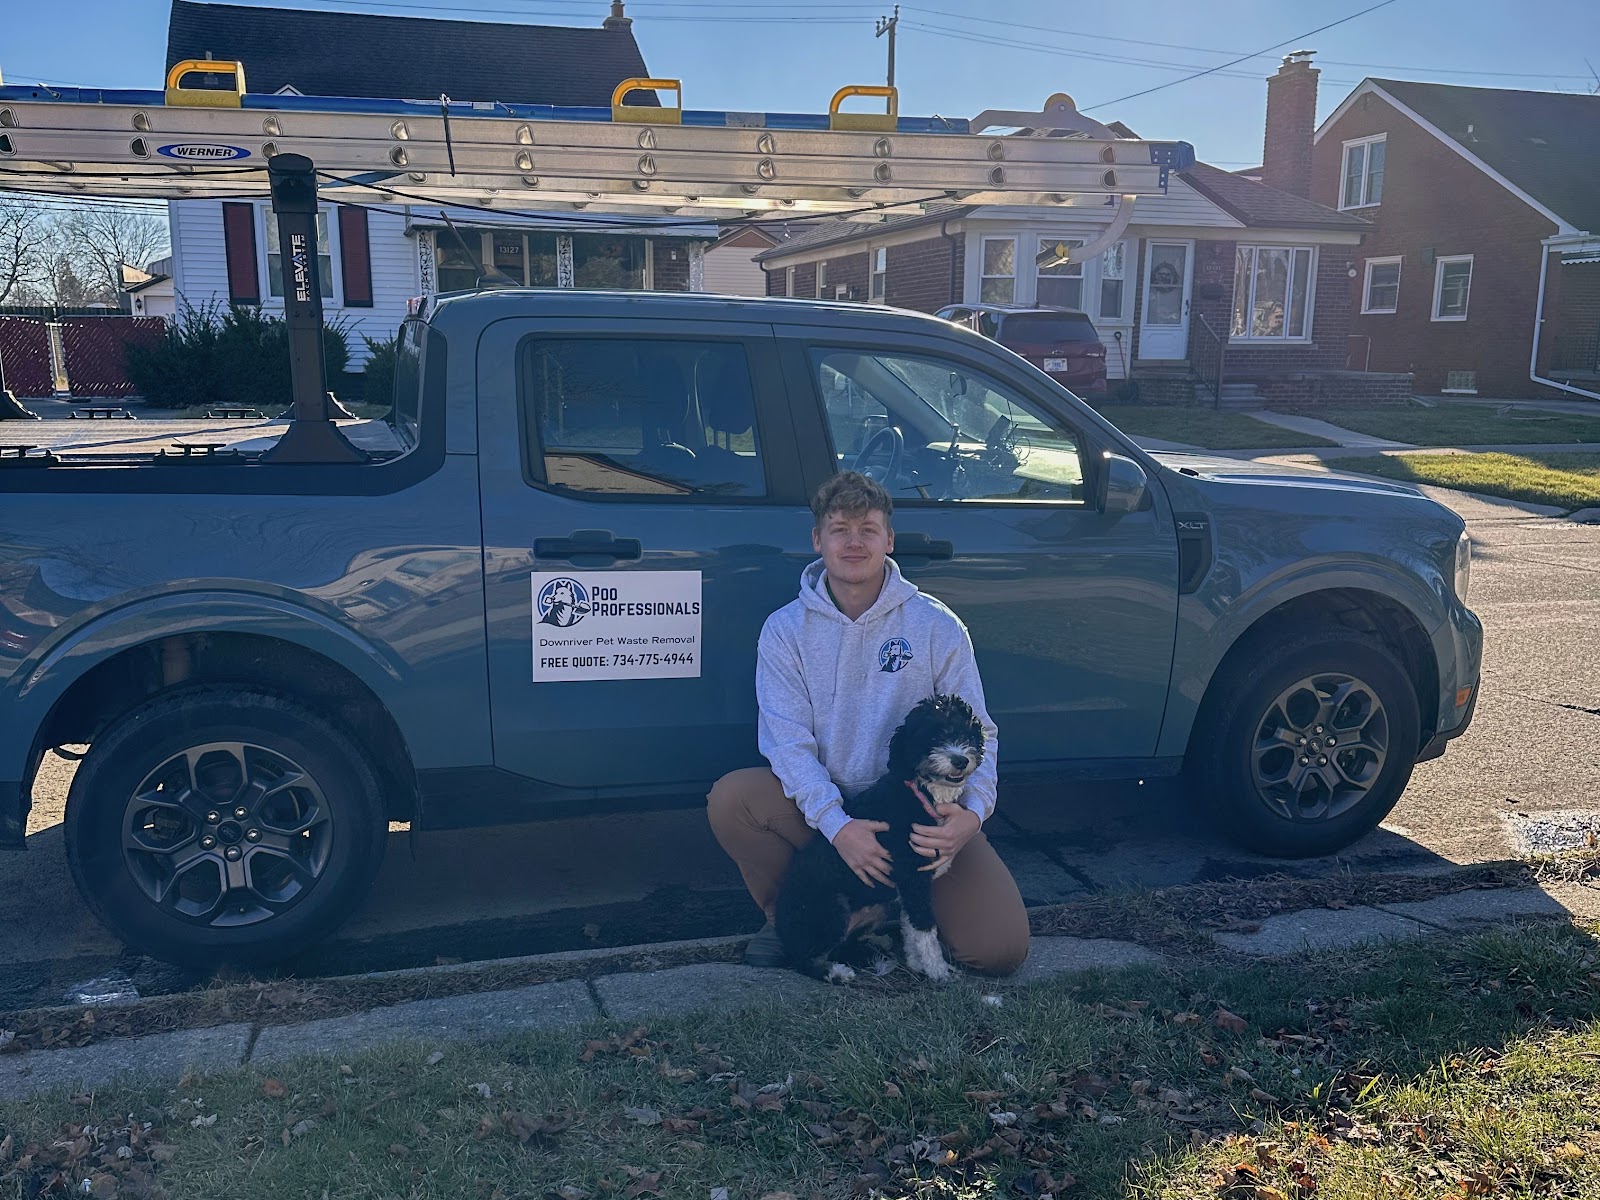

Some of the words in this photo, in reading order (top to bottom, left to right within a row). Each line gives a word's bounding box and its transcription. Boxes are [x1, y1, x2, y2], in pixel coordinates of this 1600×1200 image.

[177, 147, 232, 157] WERNER
[499, 246, 520, 254] 13127
[291, 234, 307, 302] ELEVATE
[1178, 521, 1208, 530] XLT
[591, 601, 700, 616] PROFESSIONALS
[539, 638, 593, 647] Downriver
[596, 637, 614, 646] Pet
[617, 637, 648, 645] Waste
[651, 635, 695, 644] Removal
[540, 657, 569, 668] FREE
[572, 656, 609, 669] QUOTE:
[612, 653, 694, 666] 734-775-4944
